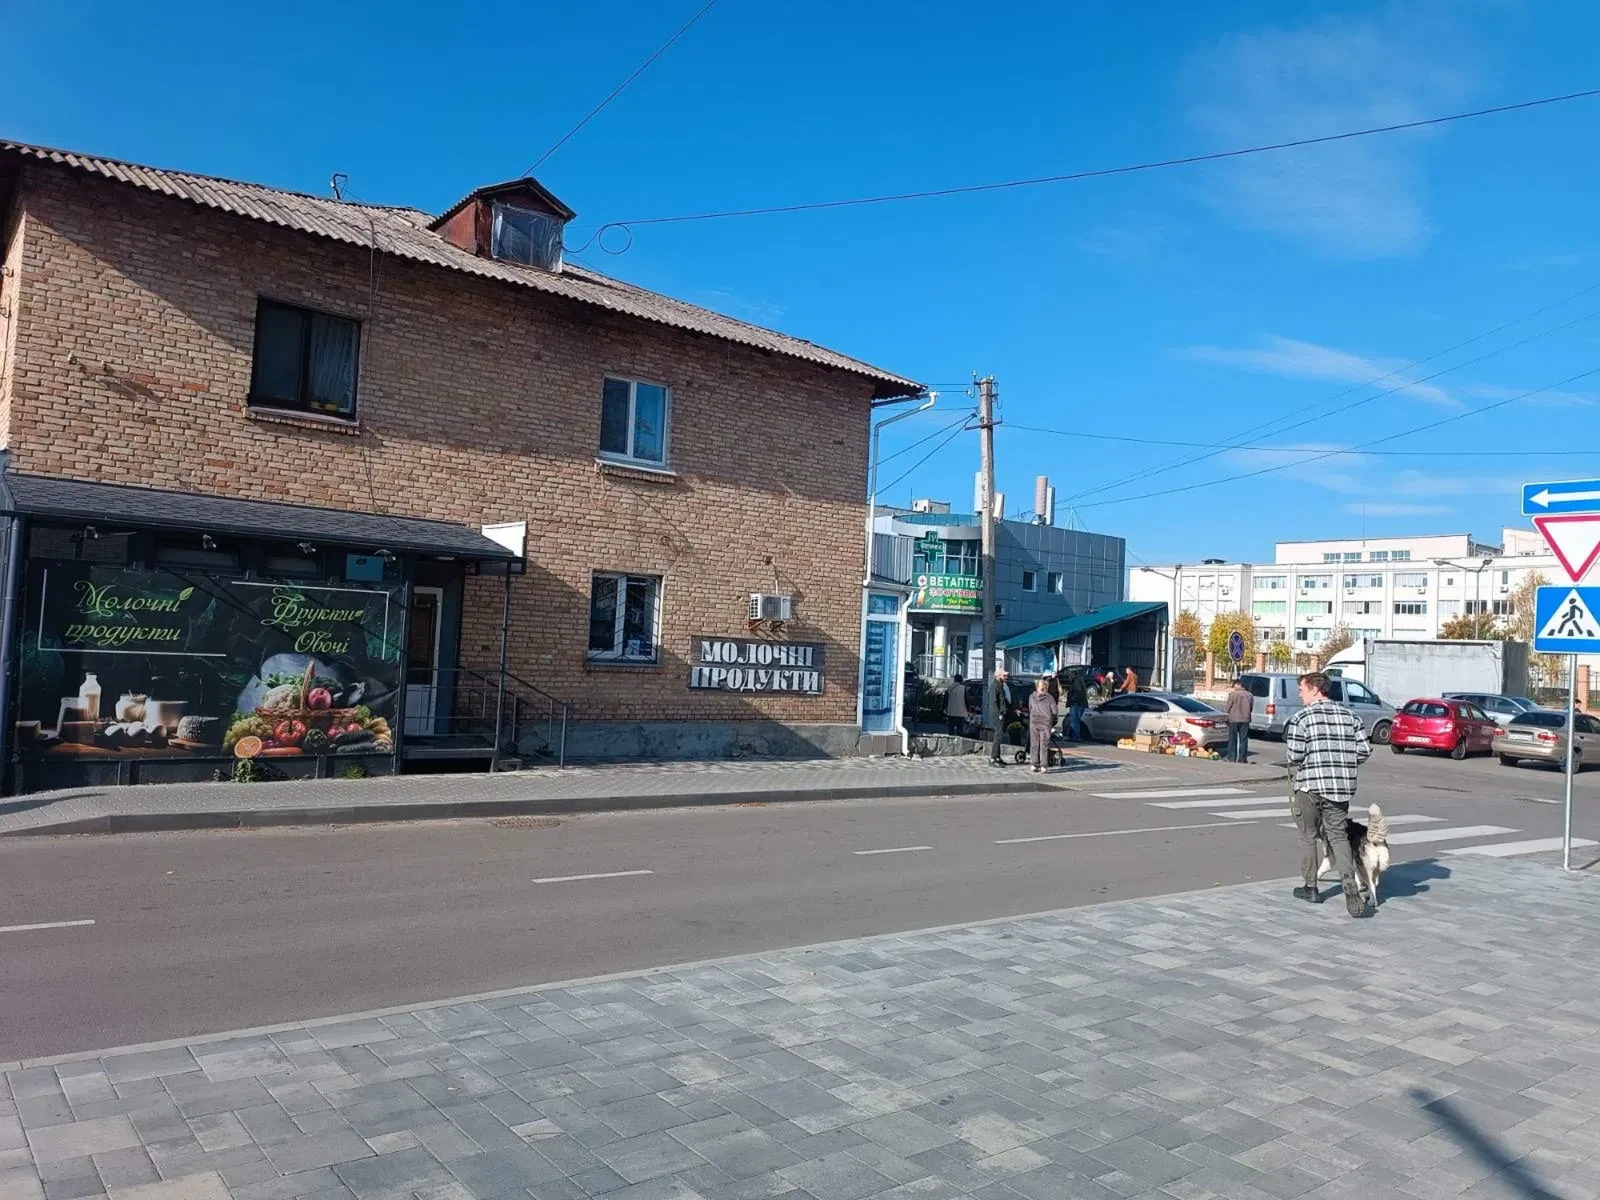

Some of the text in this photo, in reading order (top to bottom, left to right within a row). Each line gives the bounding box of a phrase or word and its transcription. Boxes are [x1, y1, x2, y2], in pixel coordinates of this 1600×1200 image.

[73, 580, 190, 617] Молочні
[929, 587, 984, 599] ЗООТОВАР
[260, 587, 357, 632] Фрукти
[65, 624, 181, 646] продукти
[294, 630, 350, 653] Овочі
[701, 640, 814, 667] МОЛОЧНІ
[690, 666, 819, 693] ПРОДУКТИ
